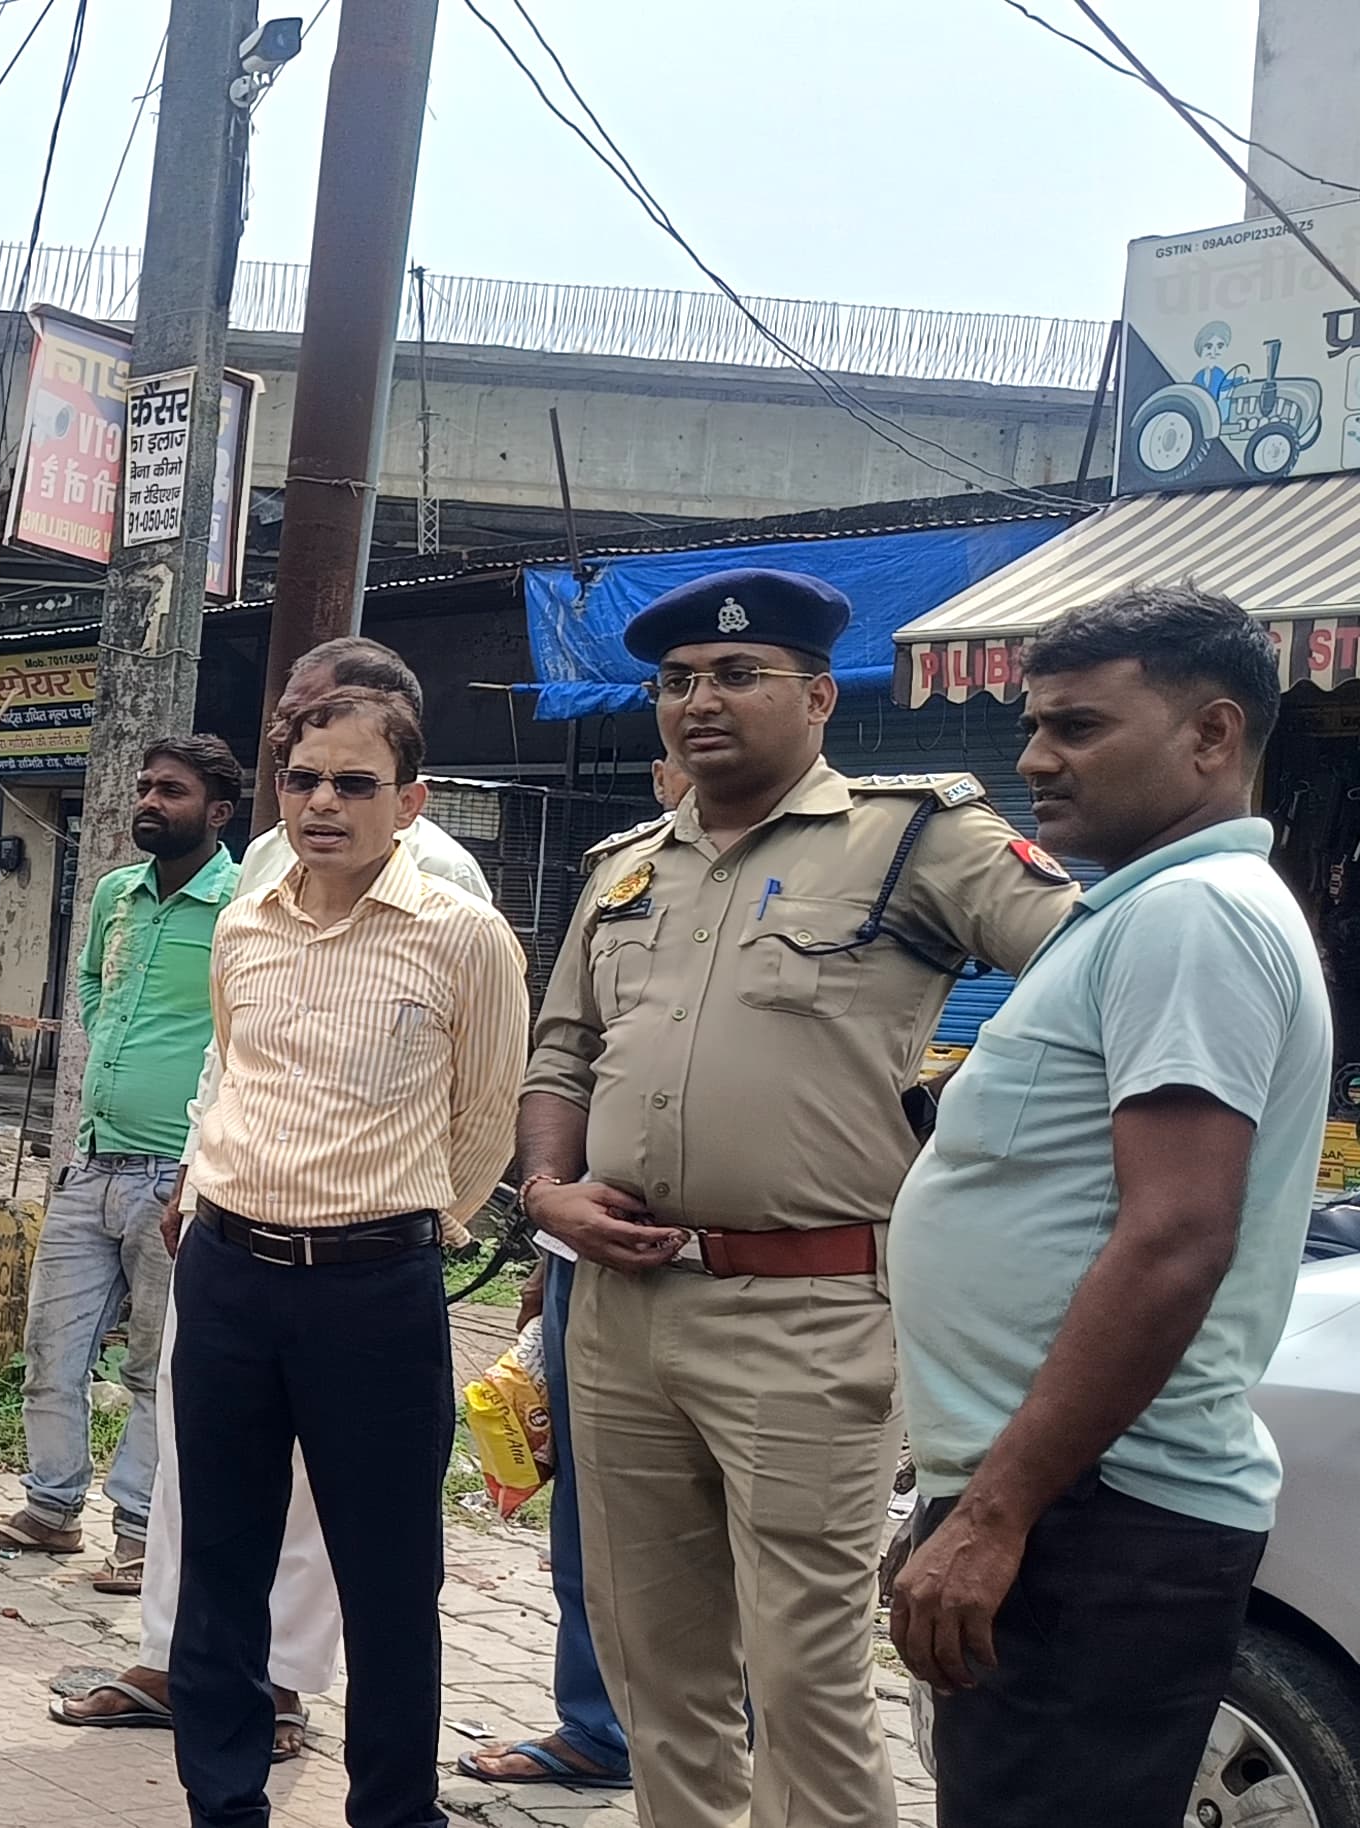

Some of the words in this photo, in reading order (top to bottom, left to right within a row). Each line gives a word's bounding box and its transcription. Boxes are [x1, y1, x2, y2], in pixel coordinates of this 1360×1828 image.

[1155, 243, 1192, 259] GSTIN
[1202, 219, 1315, 250] 09AAOPI2332RZ5
[920, 646, 1023, 689] PILIB
